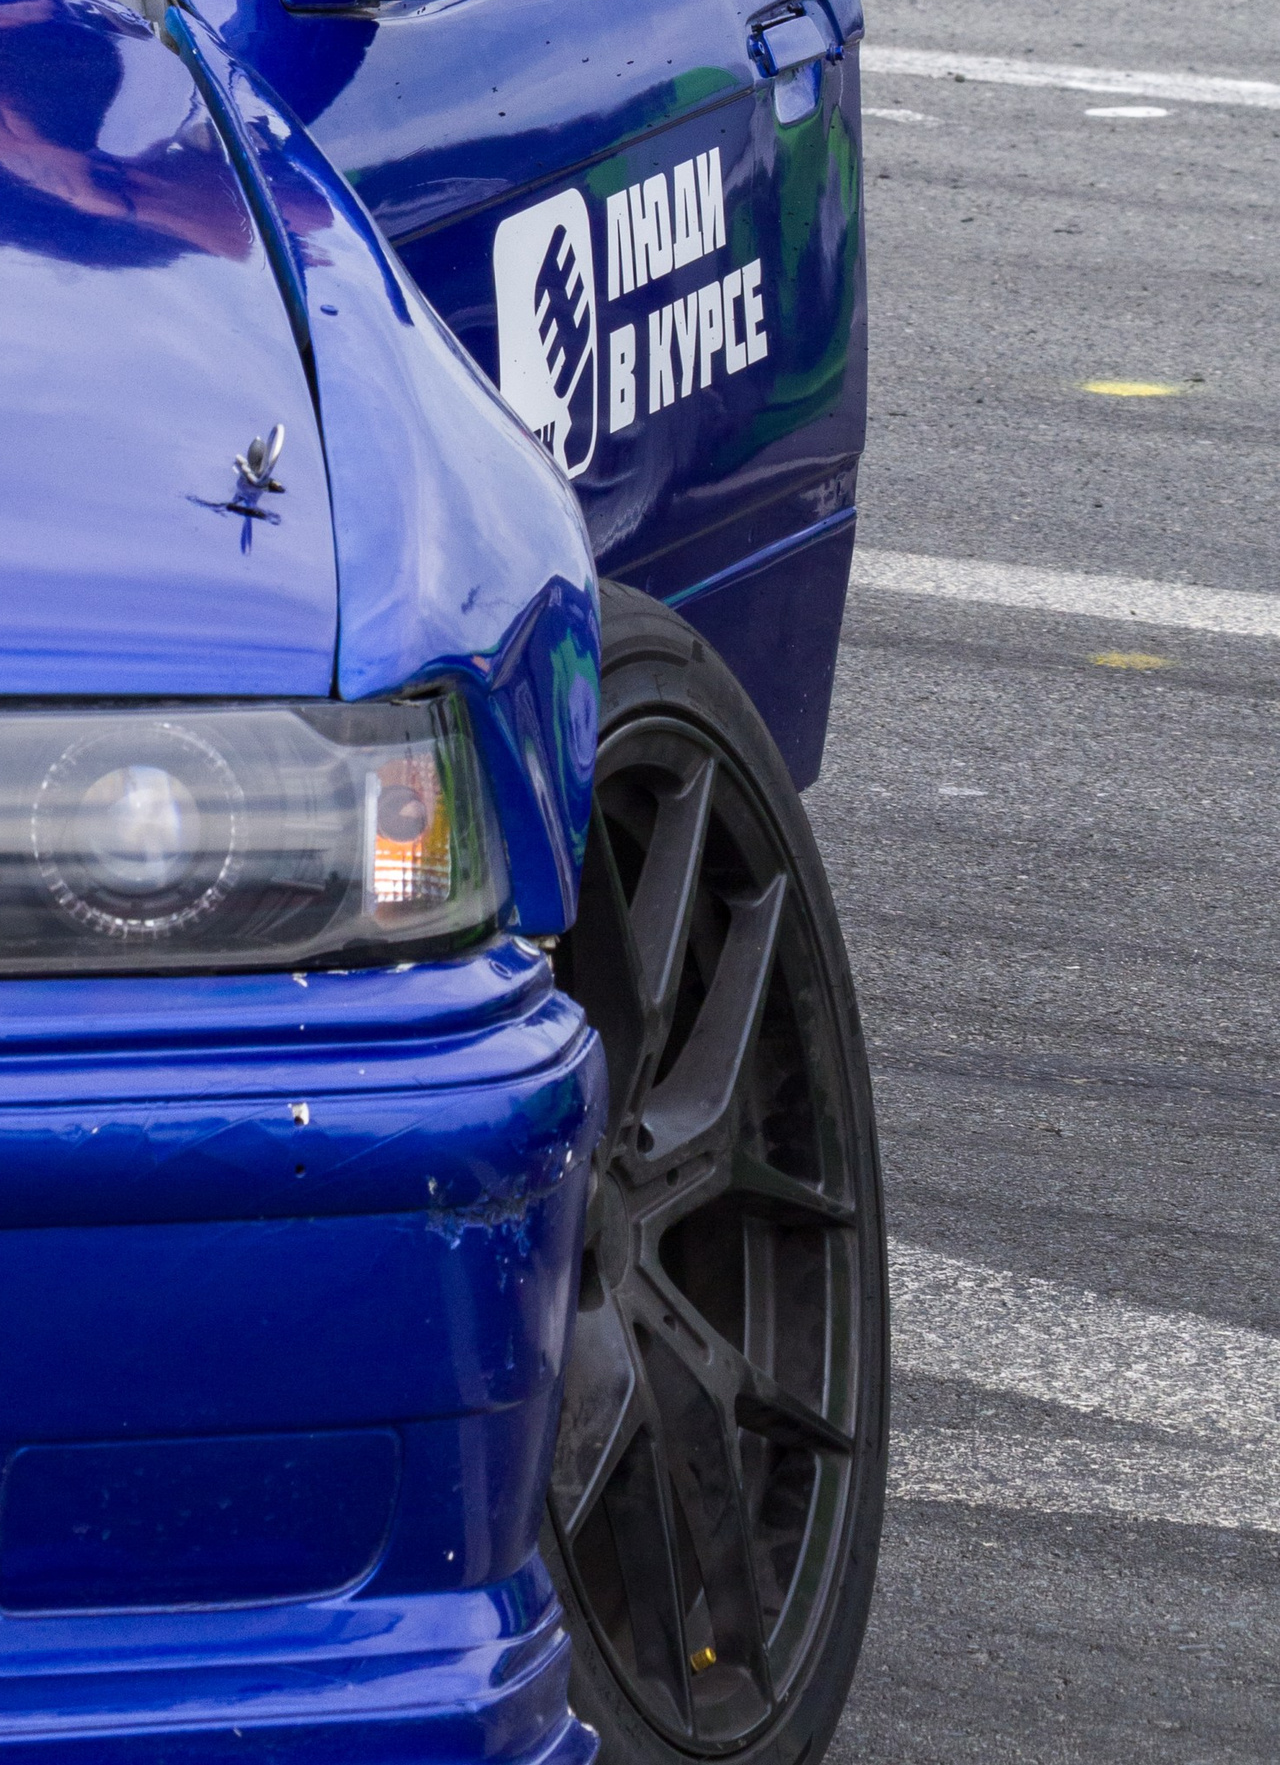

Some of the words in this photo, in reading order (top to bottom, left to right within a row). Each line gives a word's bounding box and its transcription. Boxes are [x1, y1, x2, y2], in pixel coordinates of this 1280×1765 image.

[606, 146, 726, 302] ЛЮДИ
[609, 323, 637, 434] В
[648, 258, 768, 415] КУРСЕ
